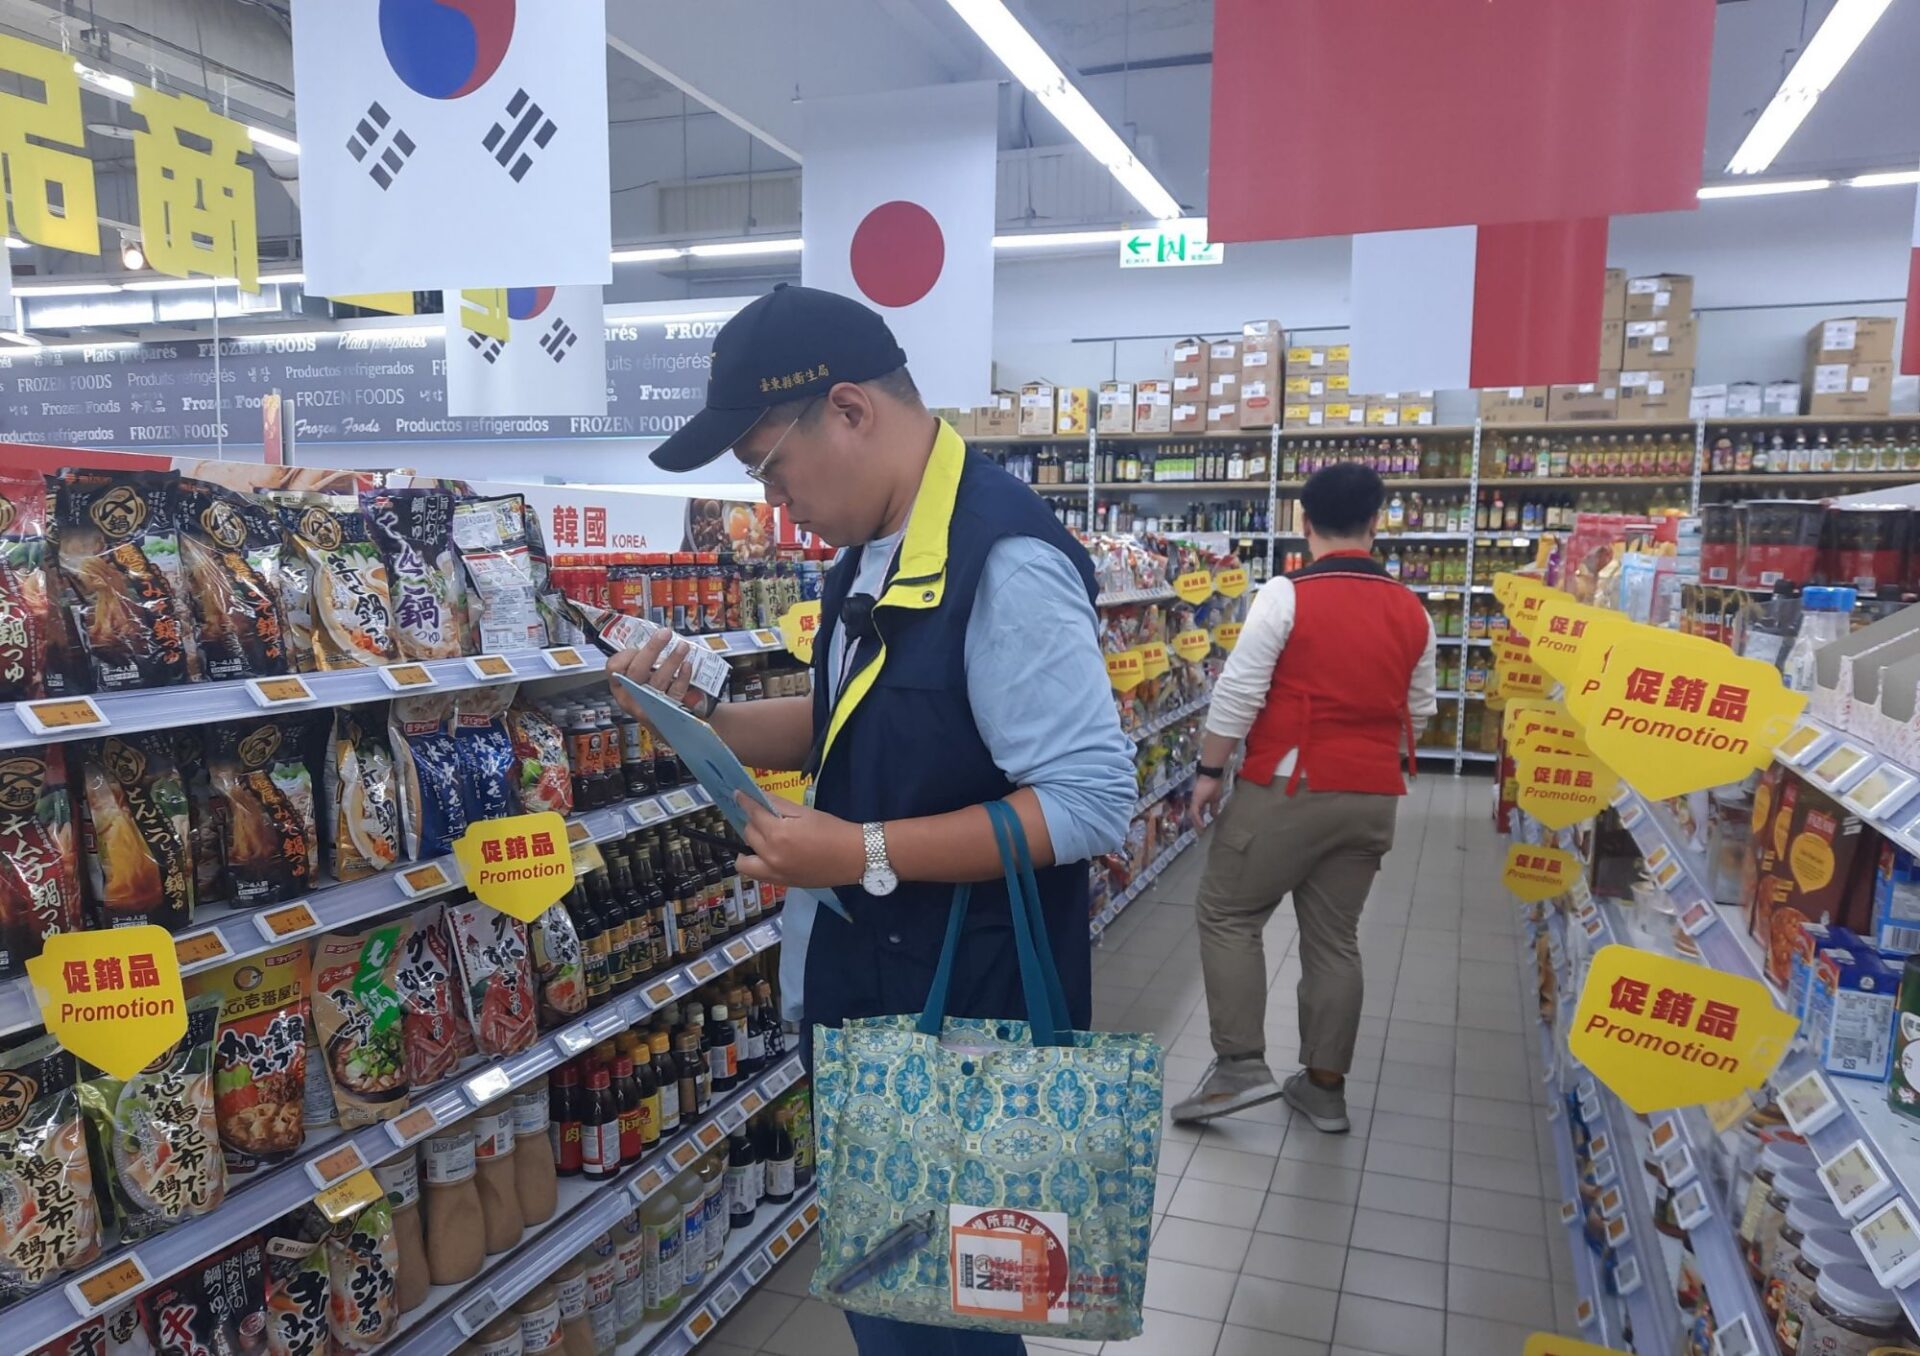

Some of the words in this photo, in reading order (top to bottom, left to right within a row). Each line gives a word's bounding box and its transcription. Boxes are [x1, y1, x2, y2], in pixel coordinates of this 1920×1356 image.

[265, 336, 317, 354] FOODS
[70, 374, 112, 390] FOODS
[285, 364, 341, 379] Productos
[86, 400, 120, 414] Foods
[355, 388, 404, 405] FOODS
[184, 423, 229, 439] FOODS
[342, 417, 381, 435] Foods
[396, 418, 463, 433] Productos
[465, 417, 549, 435] refrigerados
[569, 416, 635, 433] FROZEN
[0, 430, 46, 443] roductos
[553, 505, 607, 548] 韓國
[611, 534, 647, 548] KOREA
[1625, 667, 1750, 723] 促銷品
[1601, 707, 1749, 755] Promotion
[1534, 766, 1593, 788] 促銷品
[1524, 786, 1597, 805] Promotion
[481, 832, 555, 864] 促銷品
[479, 863, 566, 884] Promotion
[62, 953, 160, 994] 促銷品
[61, 998, 174, 1023] Promotion
[1609, 976, 1740, 1042] 促銷品
[1584, 1013, 1740, 1074] Promotion
[150, 1174, 181, 1215] 鍋つゆ
[9, 1236, 46, 1280] 鍋つゆ
[203, 1264, 225, 1314] 鍋つゆ
